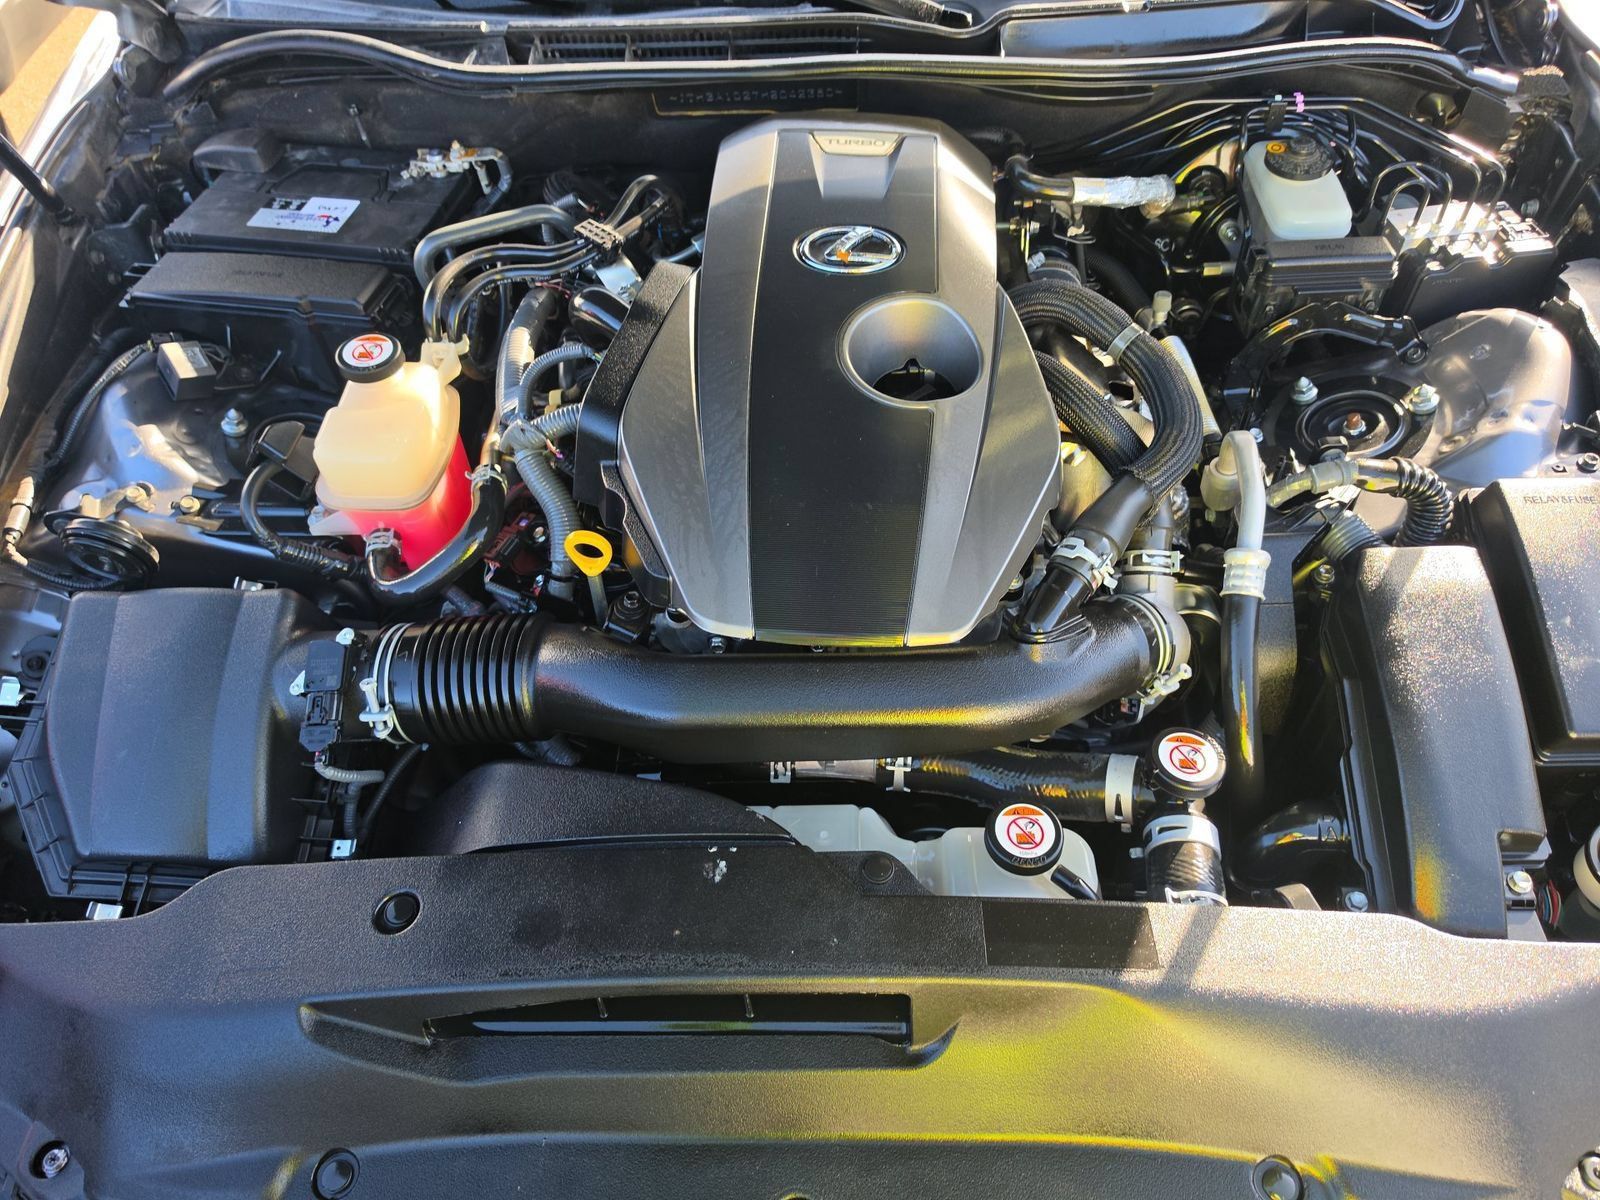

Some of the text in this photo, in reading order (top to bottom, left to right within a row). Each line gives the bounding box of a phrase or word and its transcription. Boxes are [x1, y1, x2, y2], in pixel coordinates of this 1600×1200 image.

[826, 138, 886, 147] TURBO
[1523, 495, 1597, 505] RELAY&FUSE
[1011, 855, 1048, 866] DENSO
